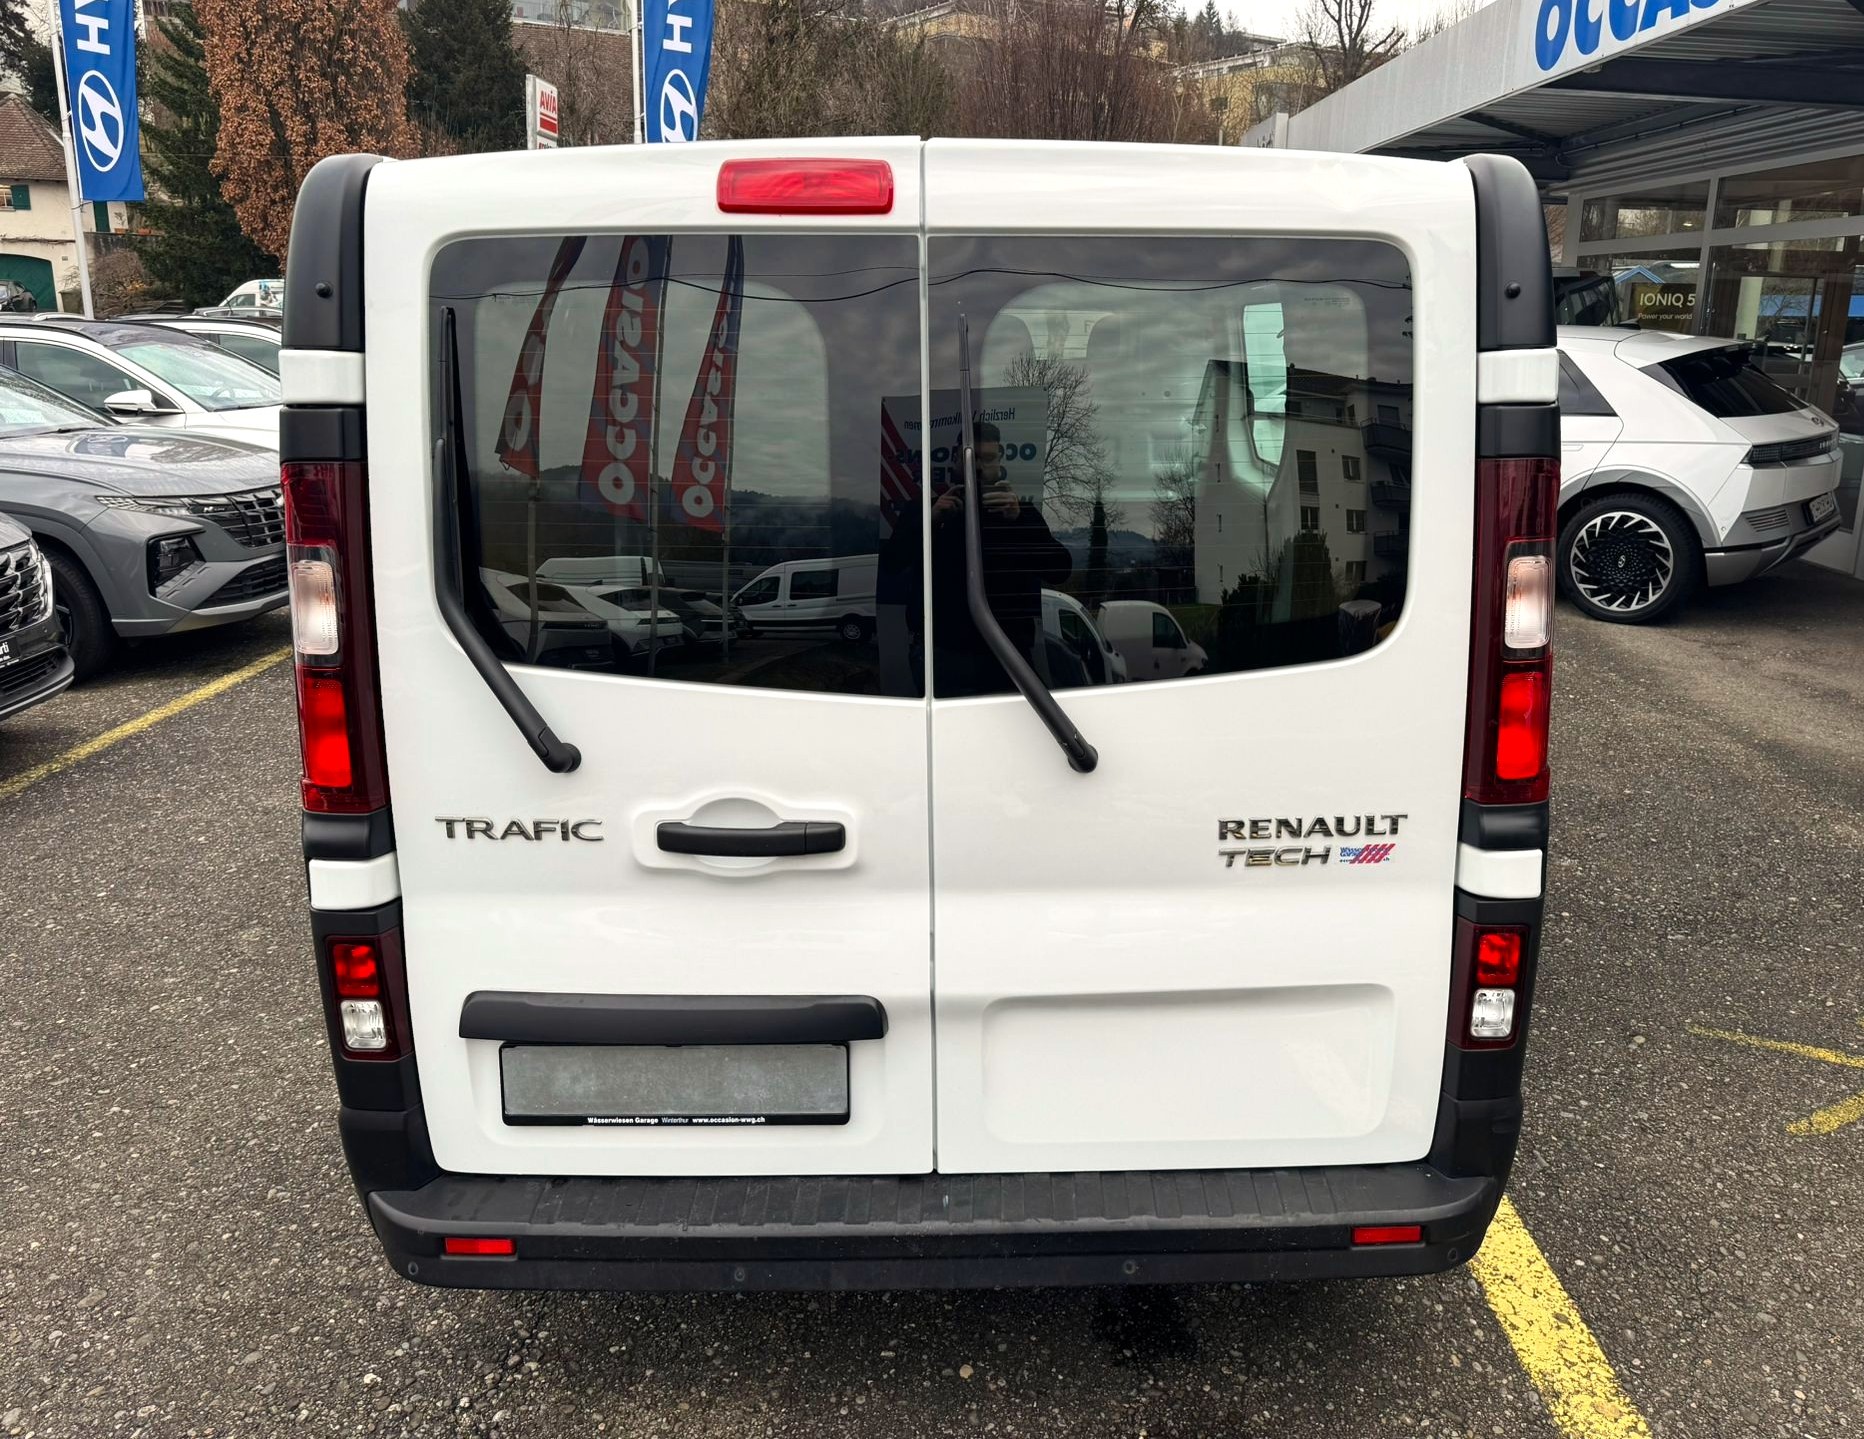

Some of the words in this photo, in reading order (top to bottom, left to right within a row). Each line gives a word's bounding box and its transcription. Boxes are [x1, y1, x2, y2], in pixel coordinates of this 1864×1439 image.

[662, 0, 693, 53] H
[1640, 293, 1684, 307] IONIQ
[1687, 294, 1696, 306] 5
[435, 815, 604, 842] TRAFIC
[1218, 814, 1408, 841] RENAULT
[1219, 844, 1331, 868] TECH
[635, 1117, 658, 1125] Garage
[692, 1116, 766, 1125] www.occasion-wwg.ch
